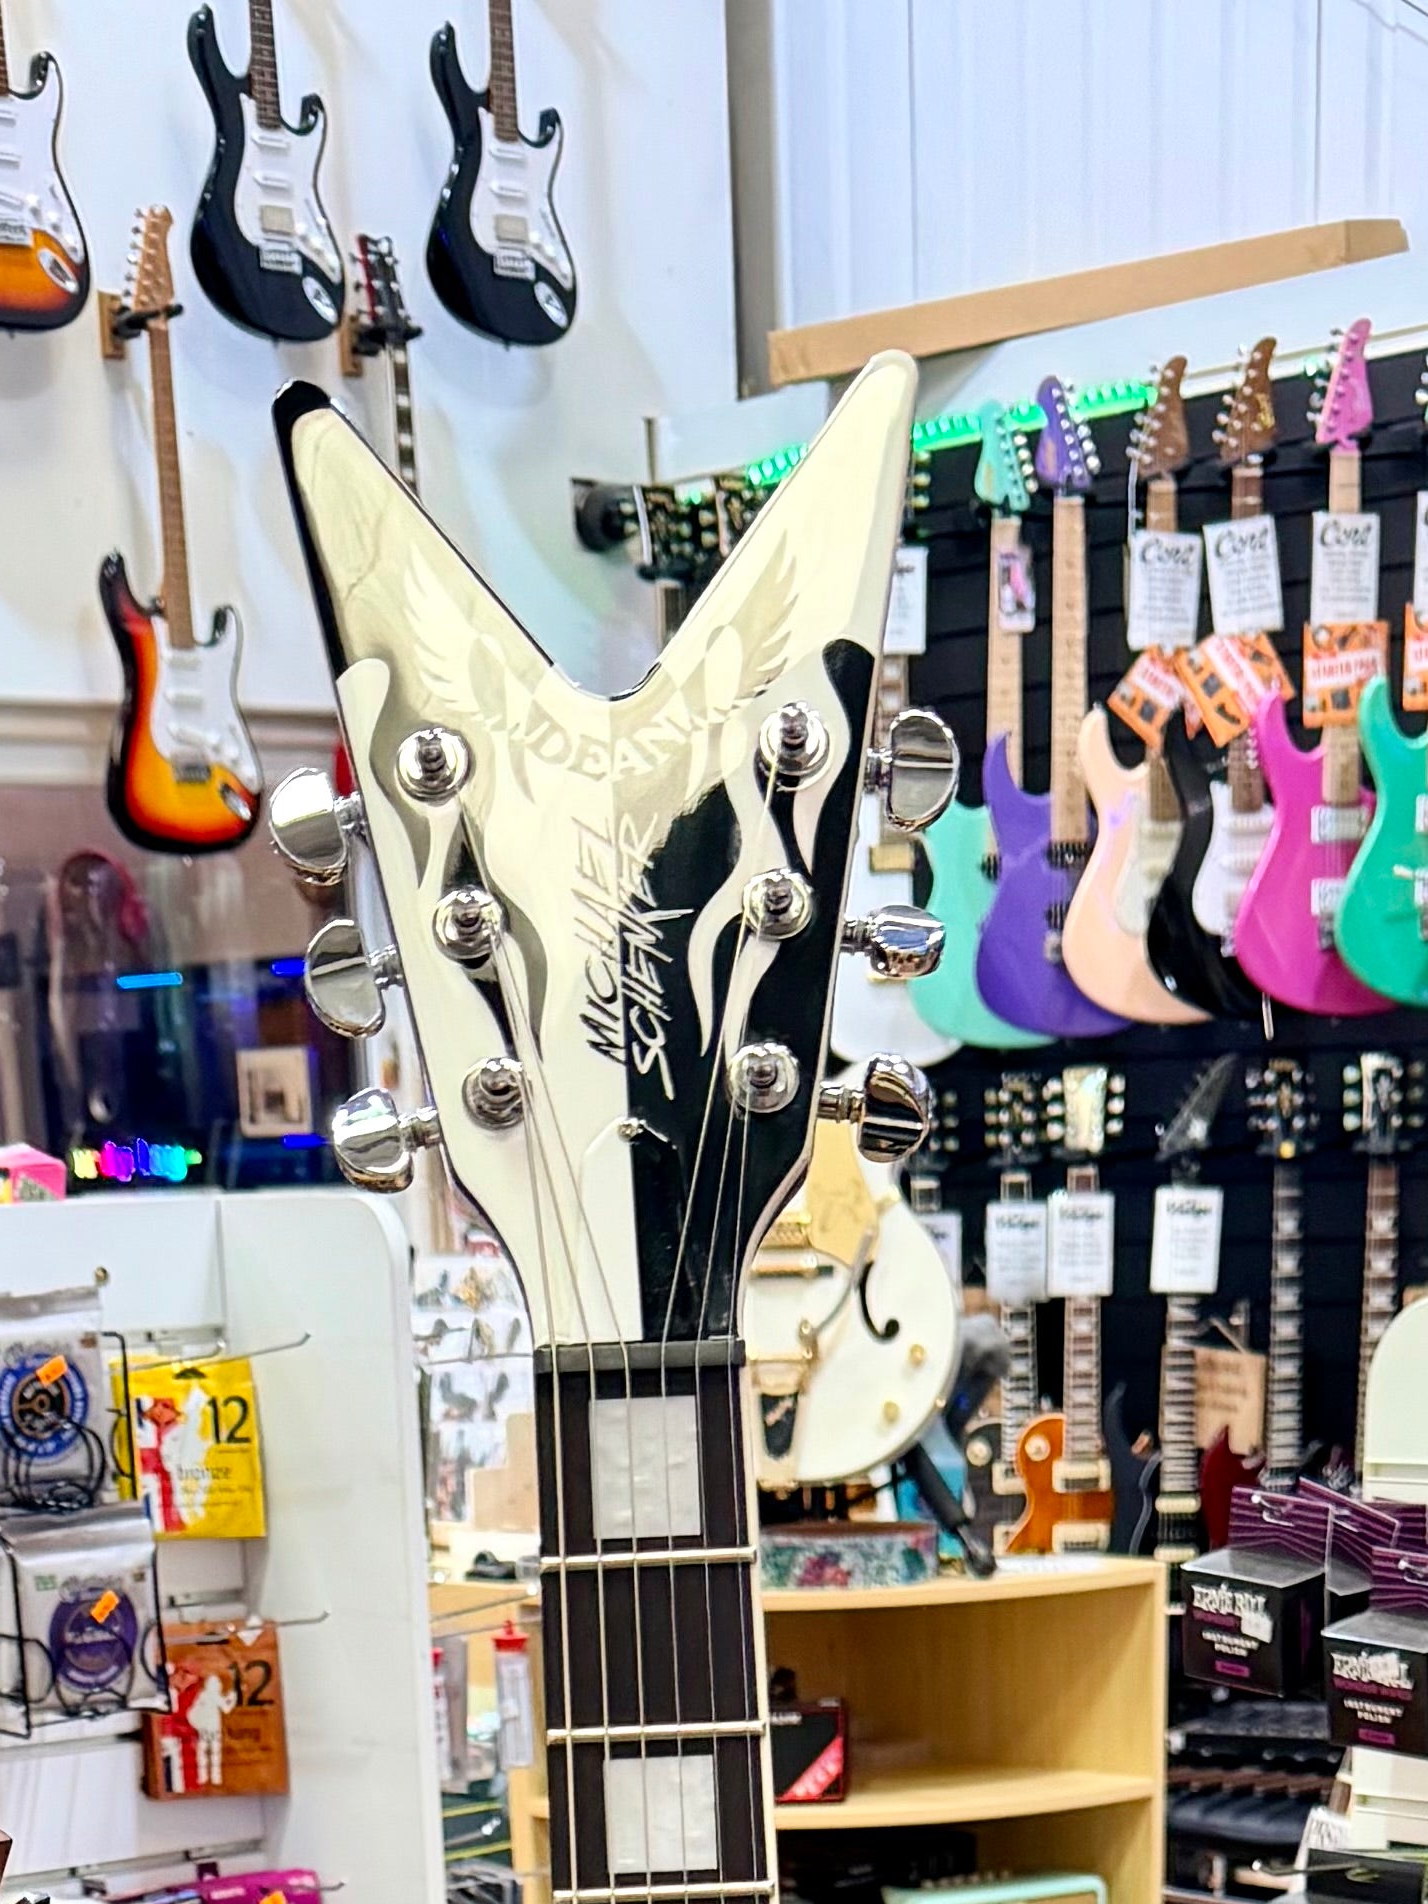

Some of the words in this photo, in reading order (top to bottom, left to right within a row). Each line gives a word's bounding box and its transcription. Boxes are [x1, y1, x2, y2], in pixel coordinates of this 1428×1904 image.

[539, 705, 692, 782] DEAN
[206, 1395, 252, 1446] 12
[229, 1660, 274, 1708] 12
